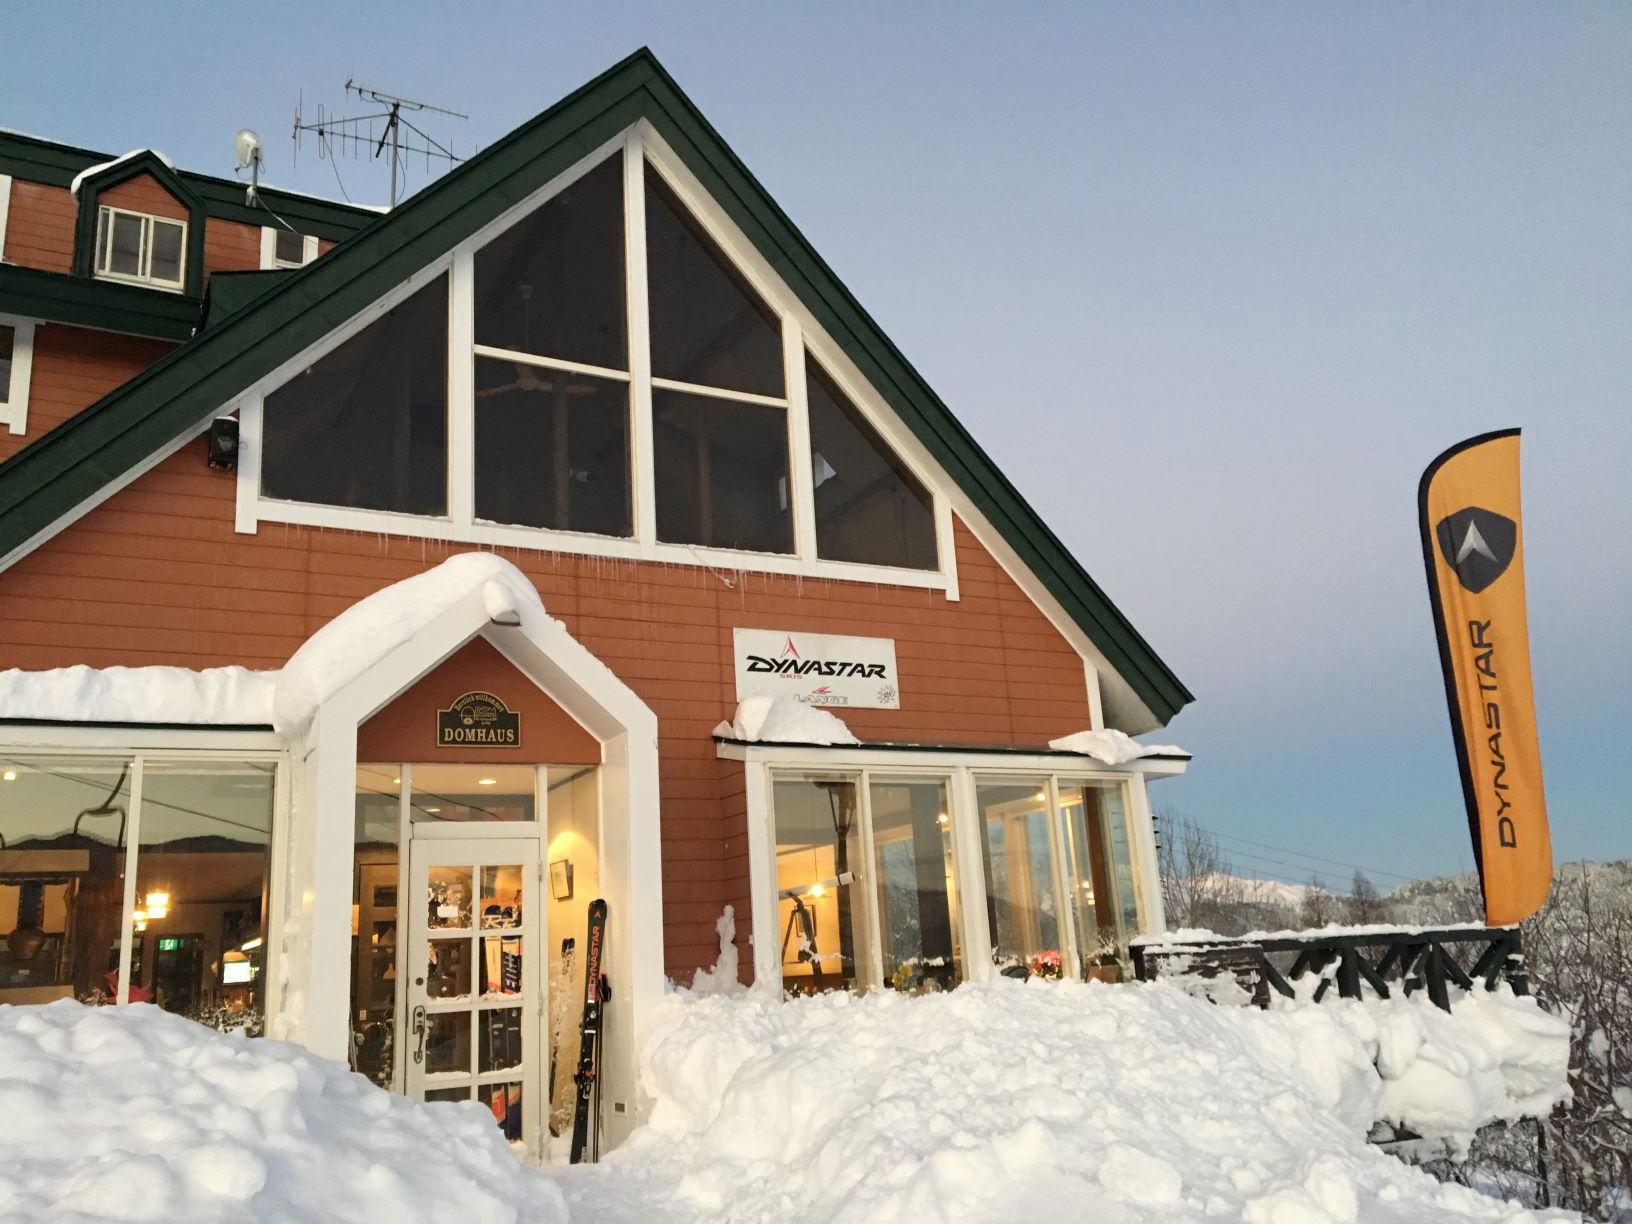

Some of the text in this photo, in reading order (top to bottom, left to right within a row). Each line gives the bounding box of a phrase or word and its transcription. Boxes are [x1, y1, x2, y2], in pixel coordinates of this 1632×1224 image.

[746, 655, 887, 679] DYNASTAR
[444, 727, 515, 743] DOMHAUS
[1469, 620, 1517, 849] DYNASTAR
[589, 925, 600, 984] DYNASTAR
